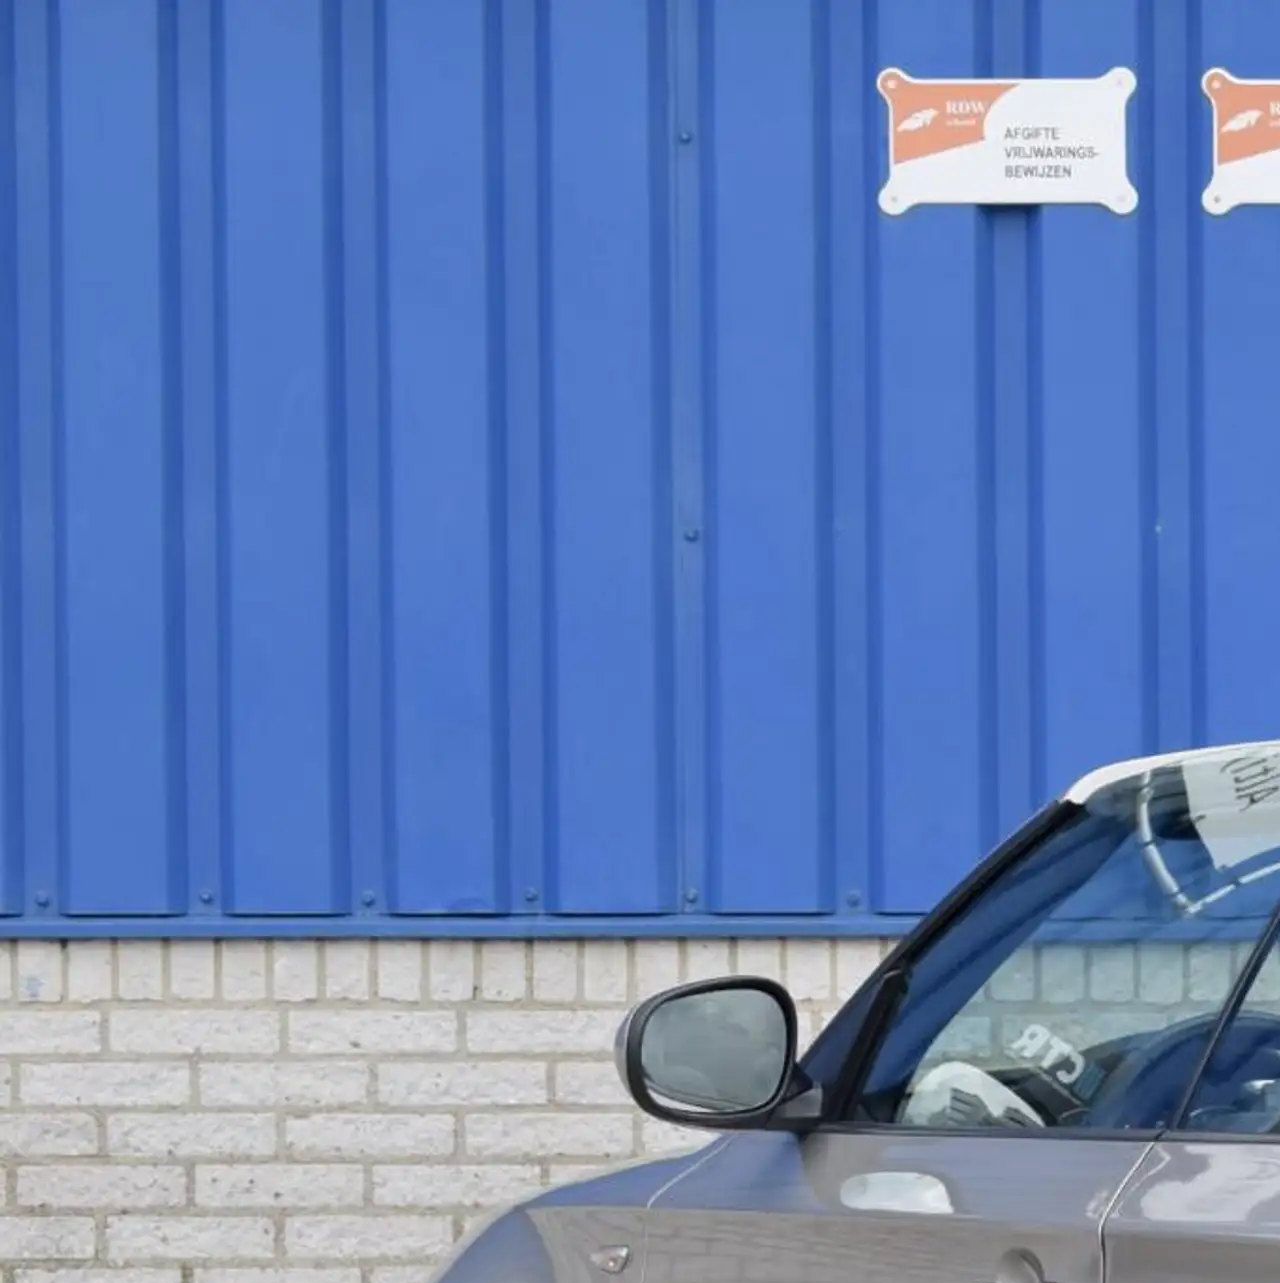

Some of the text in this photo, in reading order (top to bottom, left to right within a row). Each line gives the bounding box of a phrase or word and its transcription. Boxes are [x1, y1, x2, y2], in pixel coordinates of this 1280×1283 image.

[945, 100, 987, 115] RDW
[1004, 126, 1061, 141] AFGIFTE
[1004, 164, 1073, 179] BEWIJZEN
